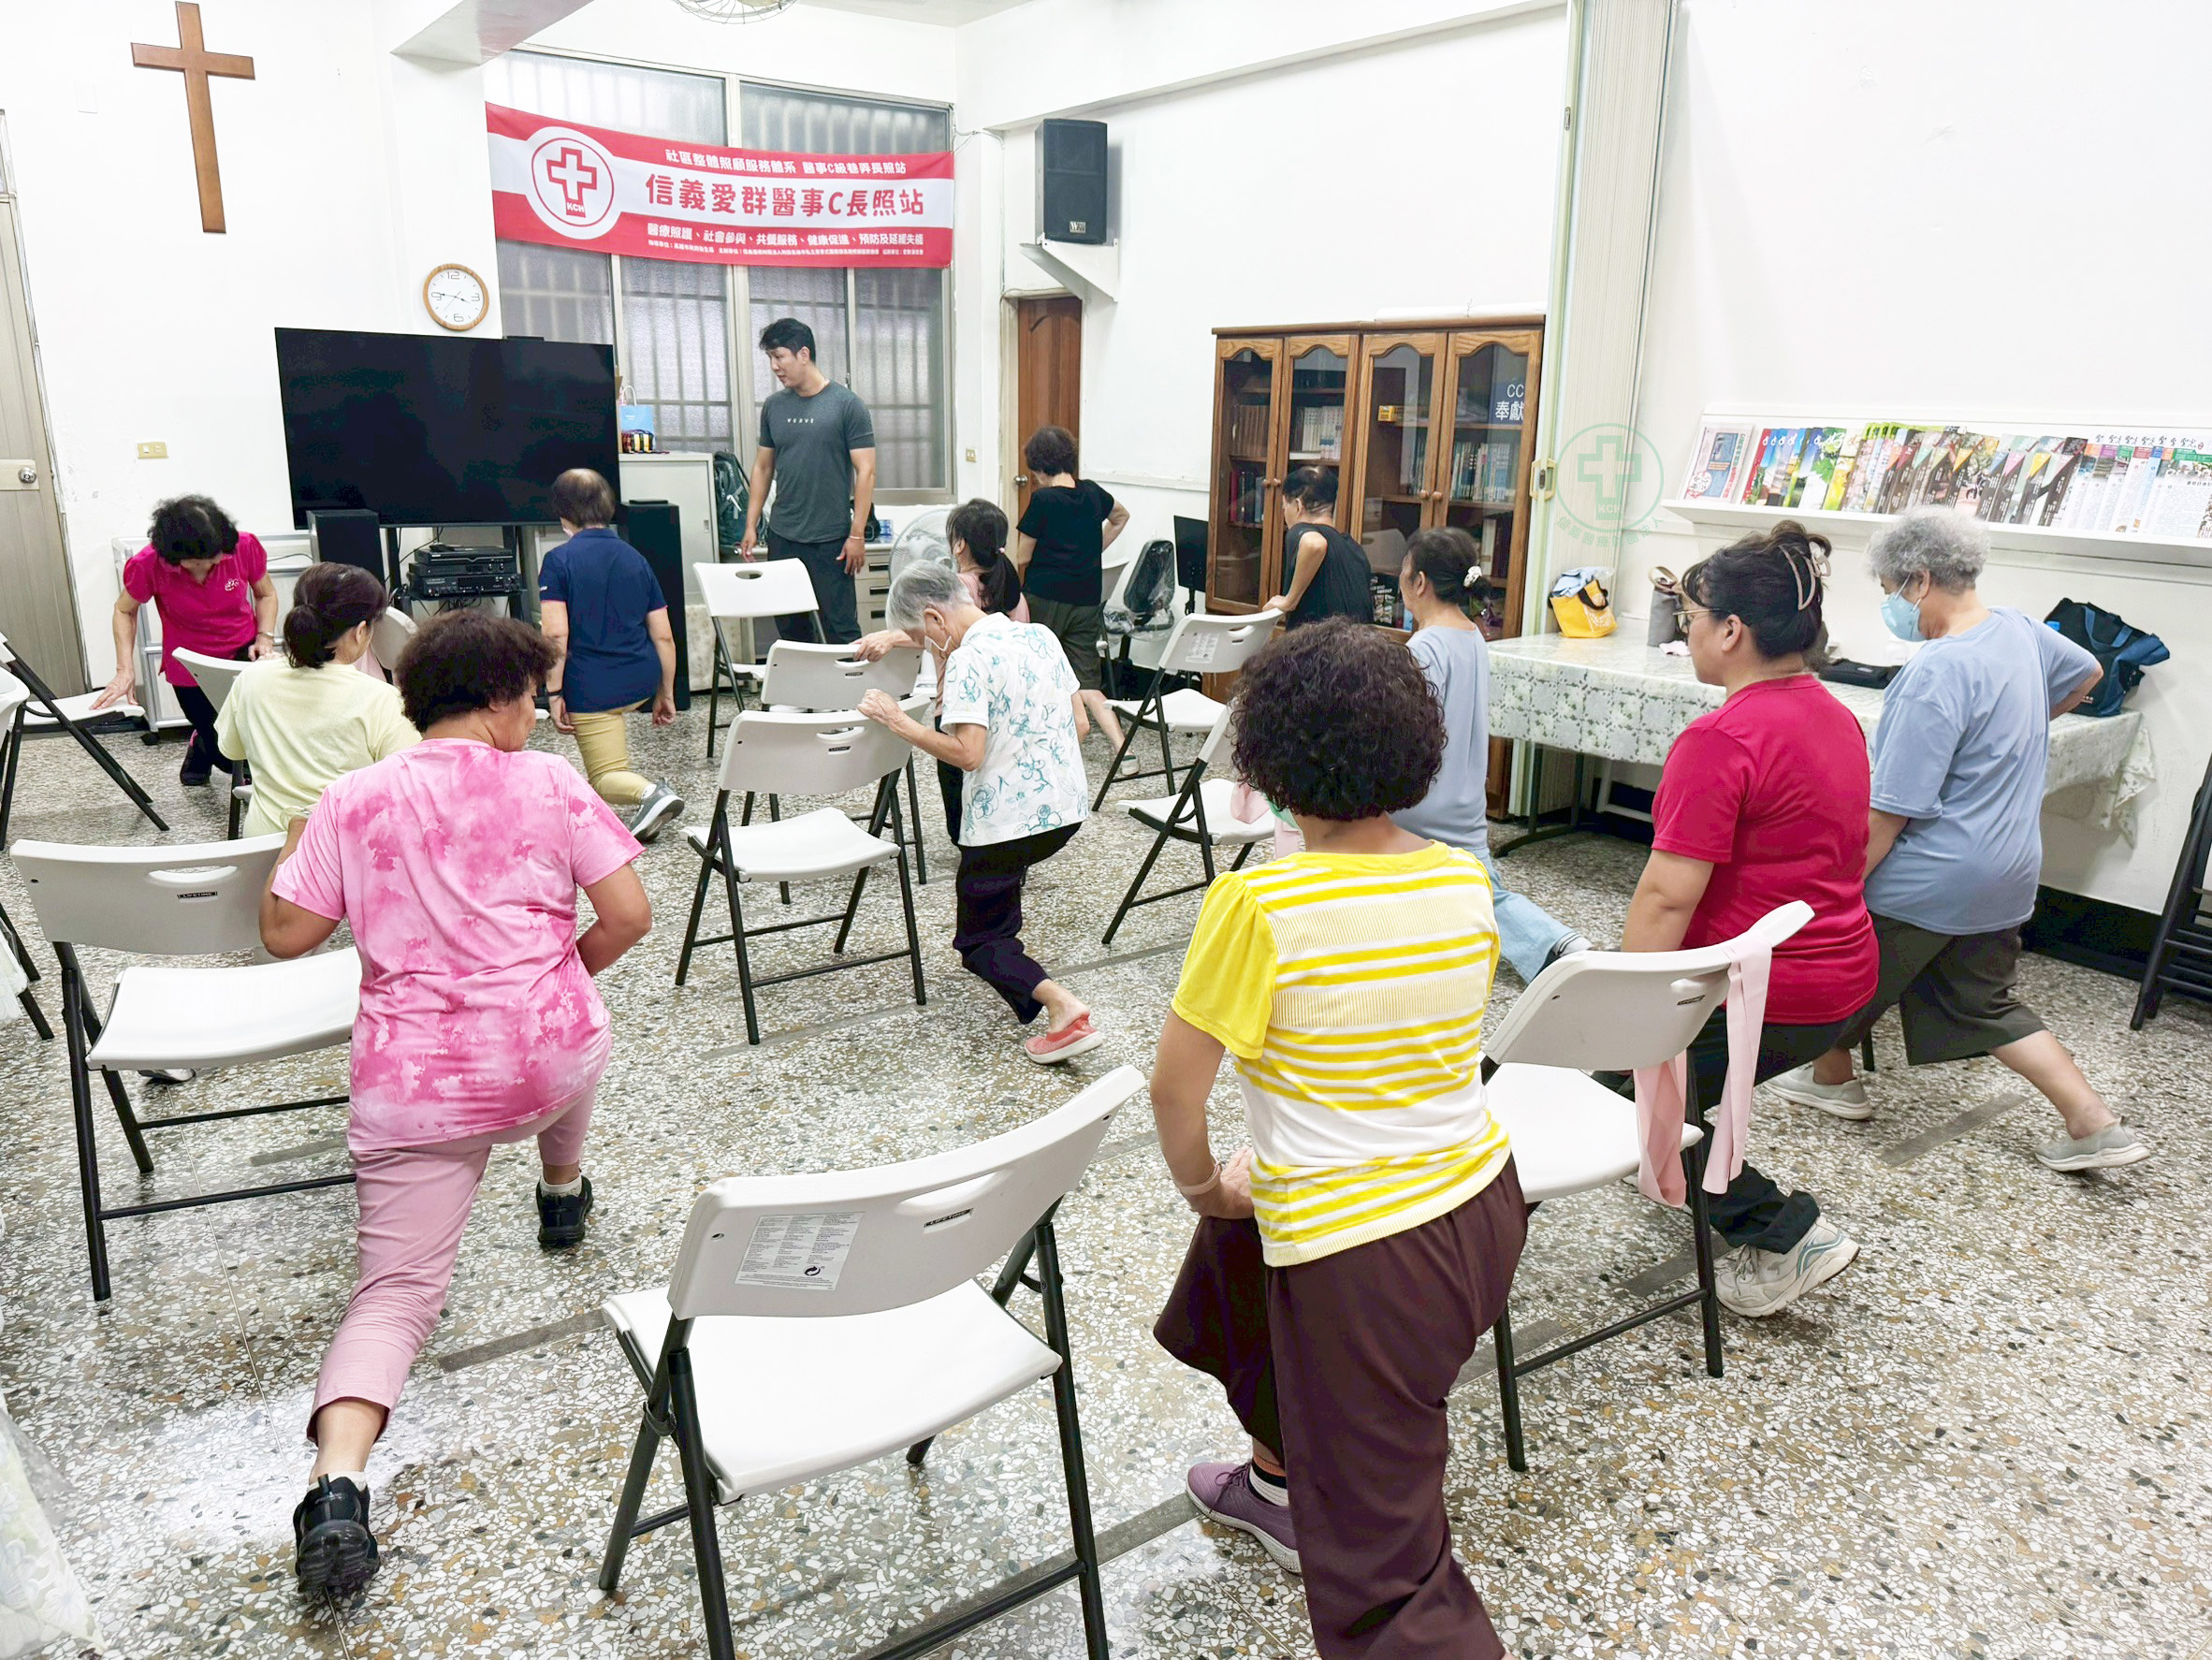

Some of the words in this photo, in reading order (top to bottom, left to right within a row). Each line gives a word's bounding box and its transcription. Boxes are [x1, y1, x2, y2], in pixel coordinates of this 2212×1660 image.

[665, 149, 796, 173] 社區整體照顧服務體系
[802, 161, 907, 175] 醫事C級巷弄長照站
[646, 174, 924, 217] 信義愛群醫事C長照站
[566, 201, 585, 212] KCH
[447, 271, 460, 280] 12
[431, 292, 443, 301] 9
[471, 293, 481, 302] 3
[453, 313, 464, 323] 6
